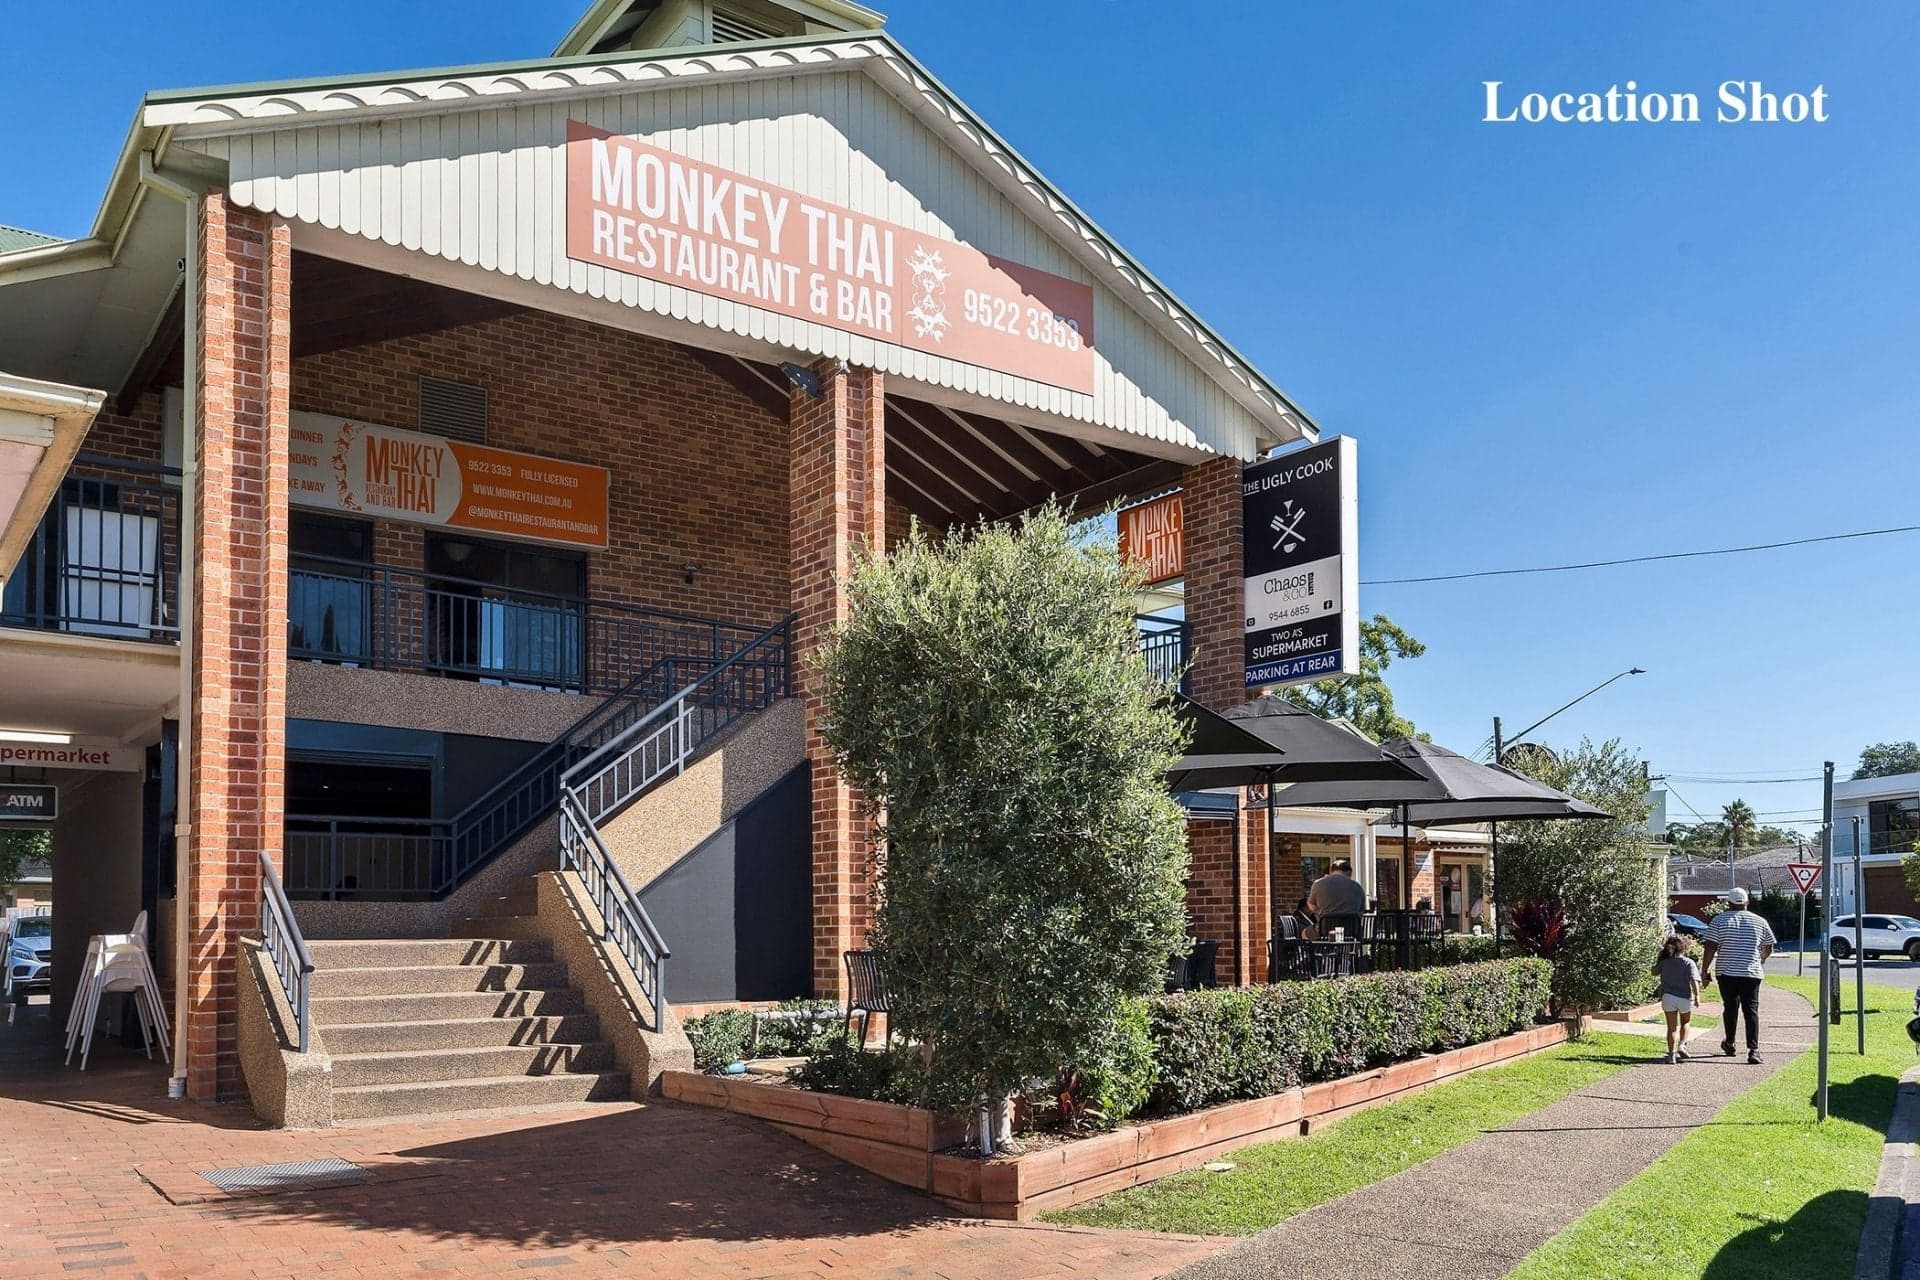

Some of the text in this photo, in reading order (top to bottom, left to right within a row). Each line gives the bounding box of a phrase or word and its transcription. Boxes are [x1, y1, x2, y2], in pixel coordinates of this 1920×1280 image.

[591, 137, 893, 287] MONKEY THAI
[593, 208, 892, 333] RESTAURANT & BAR
[963, 289, 1080, 352] 9522 3353
[290, 428, 323, 444] DINNER
[366, 435, 443, 485] MONKEY
[468, 459, 578, 488] 9522 3353 FULLY LICENSED
[301, 480, 326, 493] AWAY
[1243, 456, 1334, 494] THE UGLY COOK
[391, 465, 436, 514] THAI
[472, 483, 573, 509] WWW.MONKEYTHAI.COM.AU
[1146, 531, 1182, 578] THAI
[1264, 574, 1307, 595] Chaos
[1268, 604, 1310, 622] 9544 6855
[1252, 633, 1329, 660] SUPERMARKET
[1271, 630, 1290, 642] TWO
[1245, 655, 1336, 683] PARKING AT REAR
[0, 747, 111, 764] permarket
[6, 795, 43, 807] ATM
